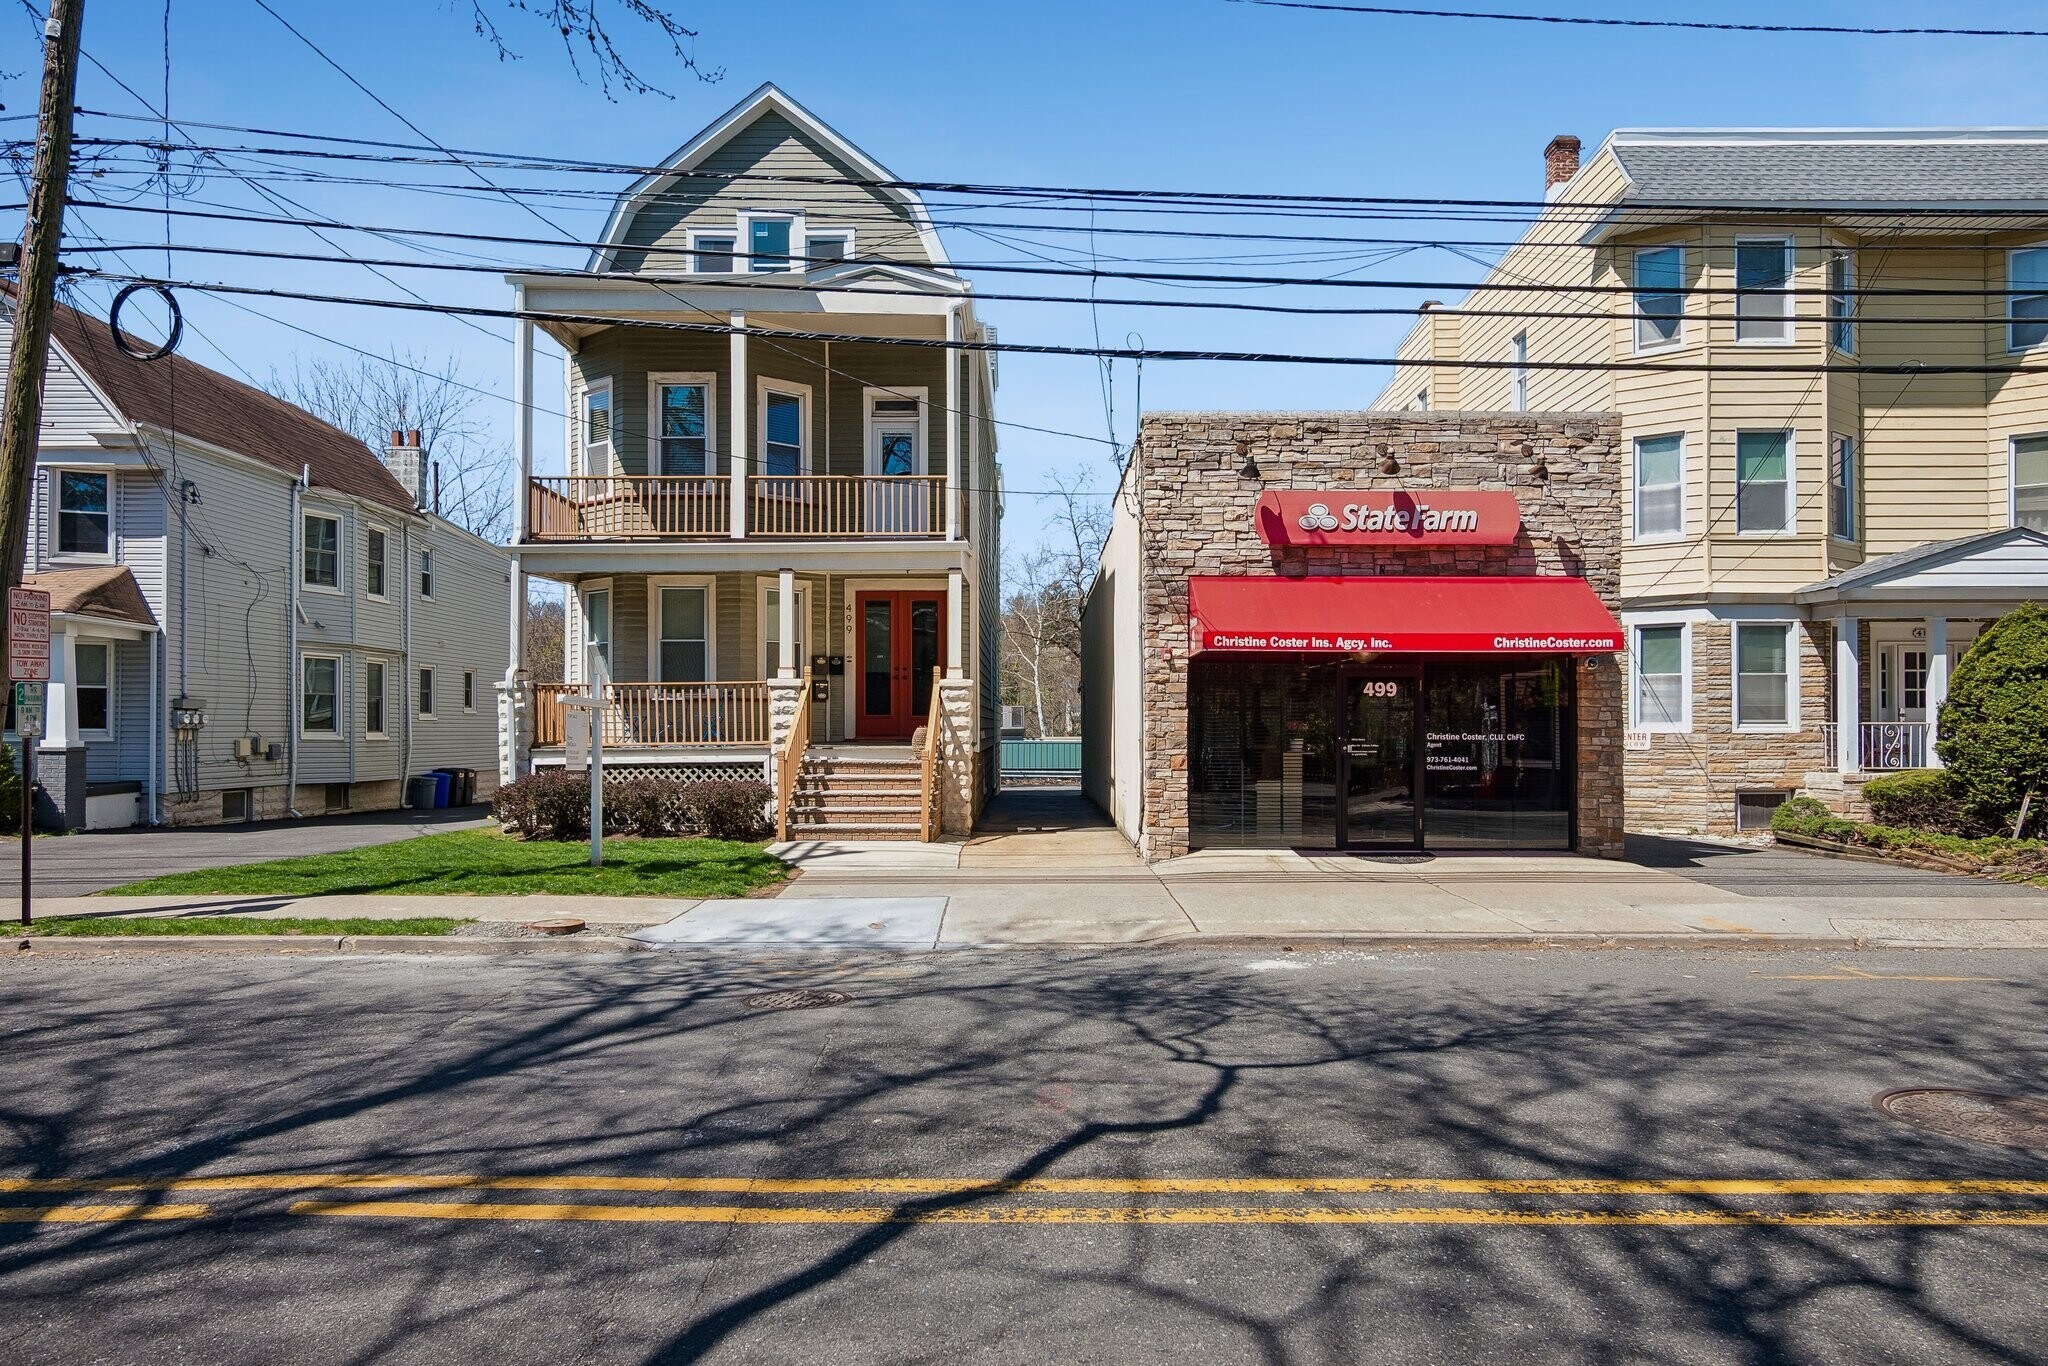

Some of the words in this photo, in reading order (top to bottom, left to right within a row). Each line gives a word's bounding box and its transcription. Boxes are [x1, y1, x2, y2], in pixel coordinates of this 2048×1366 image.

[13, 592, 23, 600] NO
[24, 593, 48, 602] PARKING
[14, 612, 26, 625] NO
[1213, 635, 1267, 648] Christine
[1270, 636, 1308, 649] Coster
[1311, 636, 1333, 649] Ins.
[1336, 637, 1368, 651] Agcy.
[1370, 637, 1393, 649] Inc.
[1493, 636, 1614, 649] ChristineCoster.com
[18, 687, 25, 701] 2
[1363, 681, 1398, 698] 499
[20, 706, 25, 714] 9
[1426, 732, 1460, 741] Christine
[1506, 733, 1525, 741] ChFC
